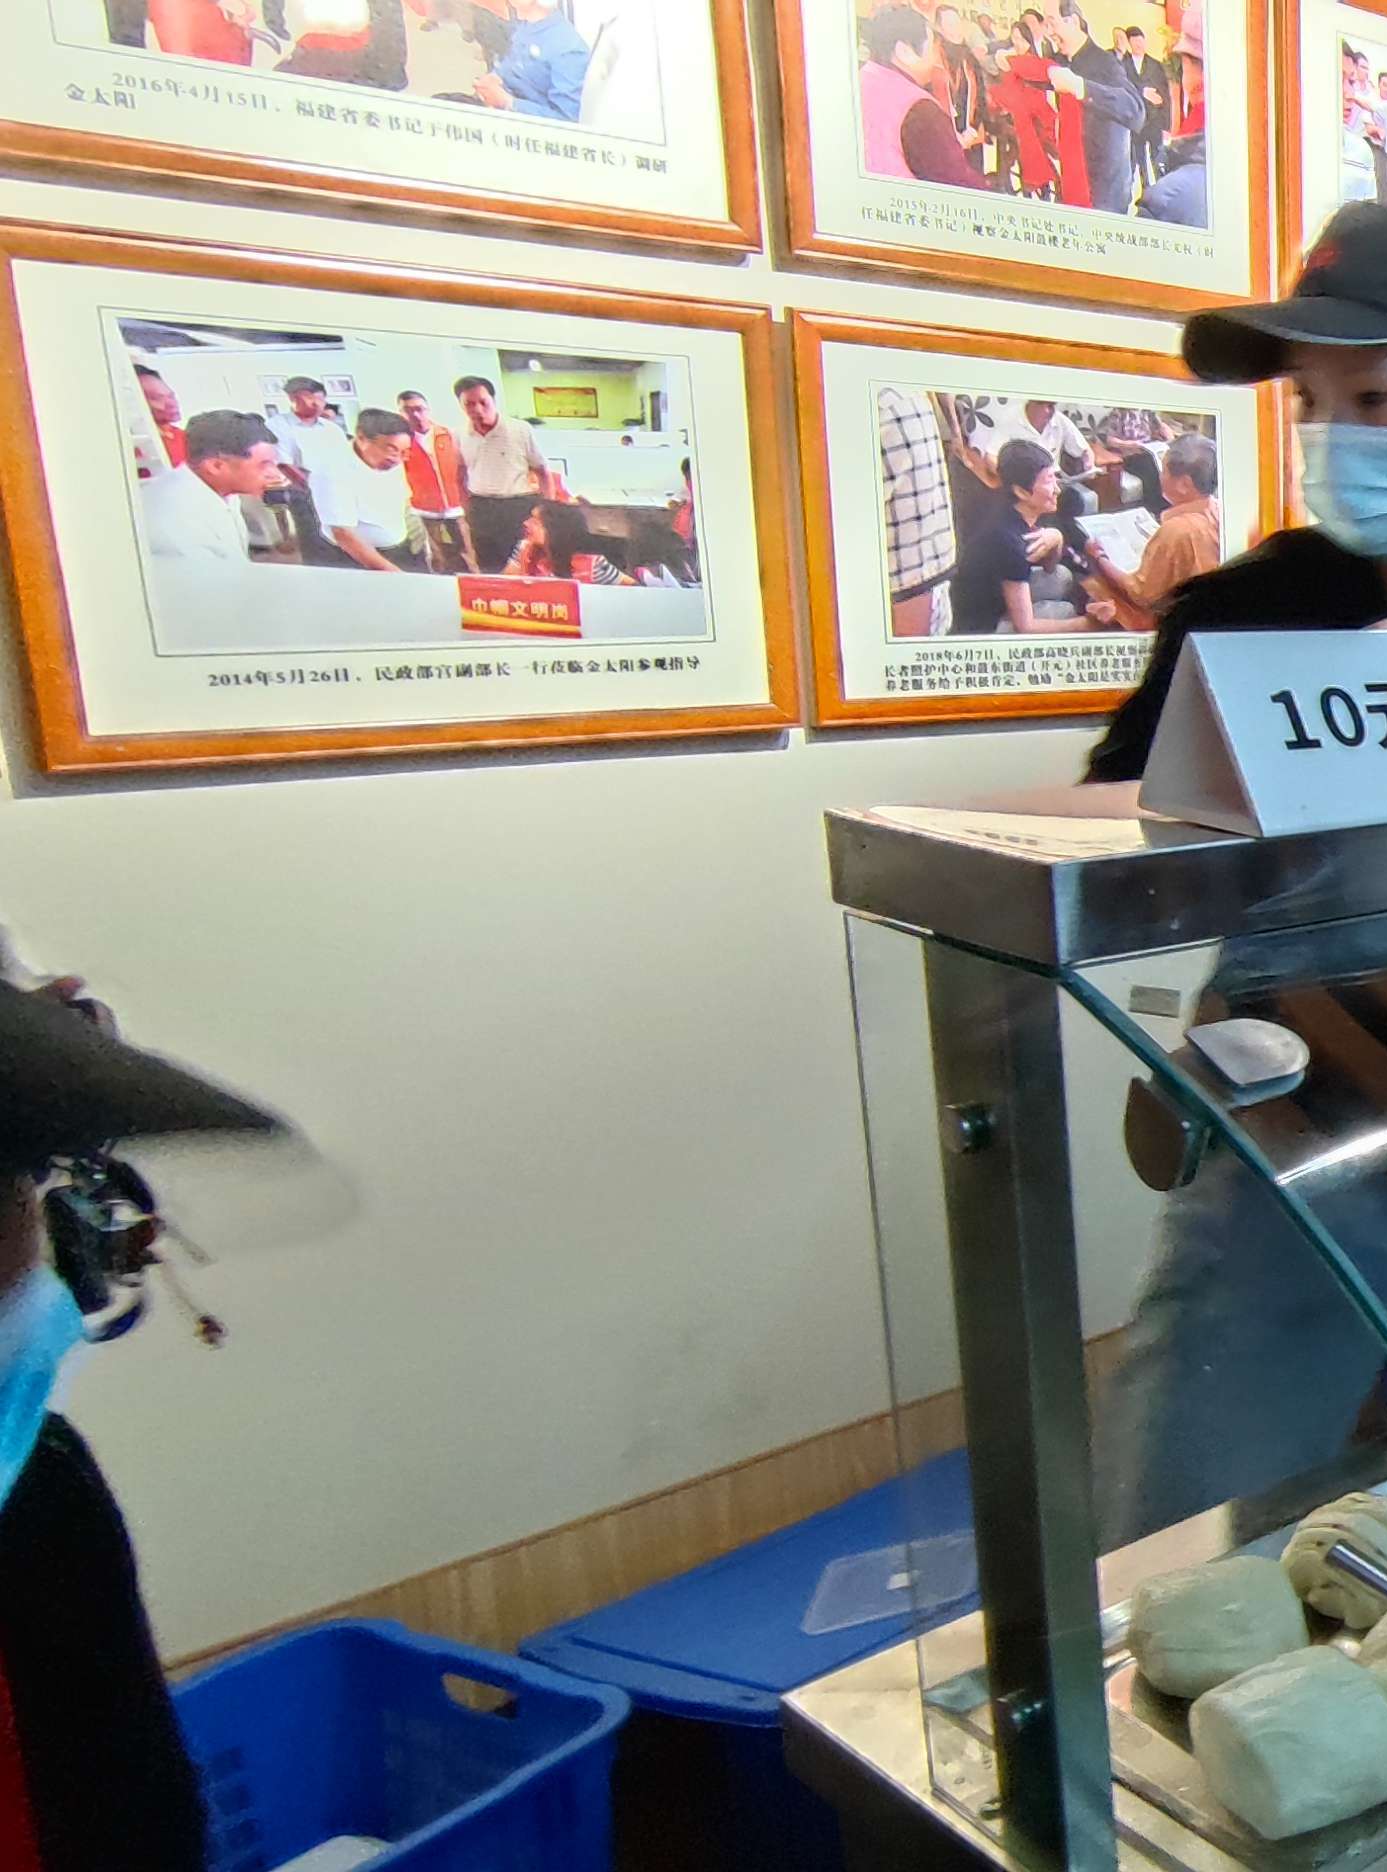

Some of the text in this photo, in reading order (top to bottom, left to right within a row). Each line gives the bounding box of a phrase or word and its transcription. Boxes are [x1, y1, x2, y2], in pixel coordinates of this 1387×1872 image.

[64, 82, 137, 111] 金太阳
[471, 597, 569, 621] 巾帼文明岗
